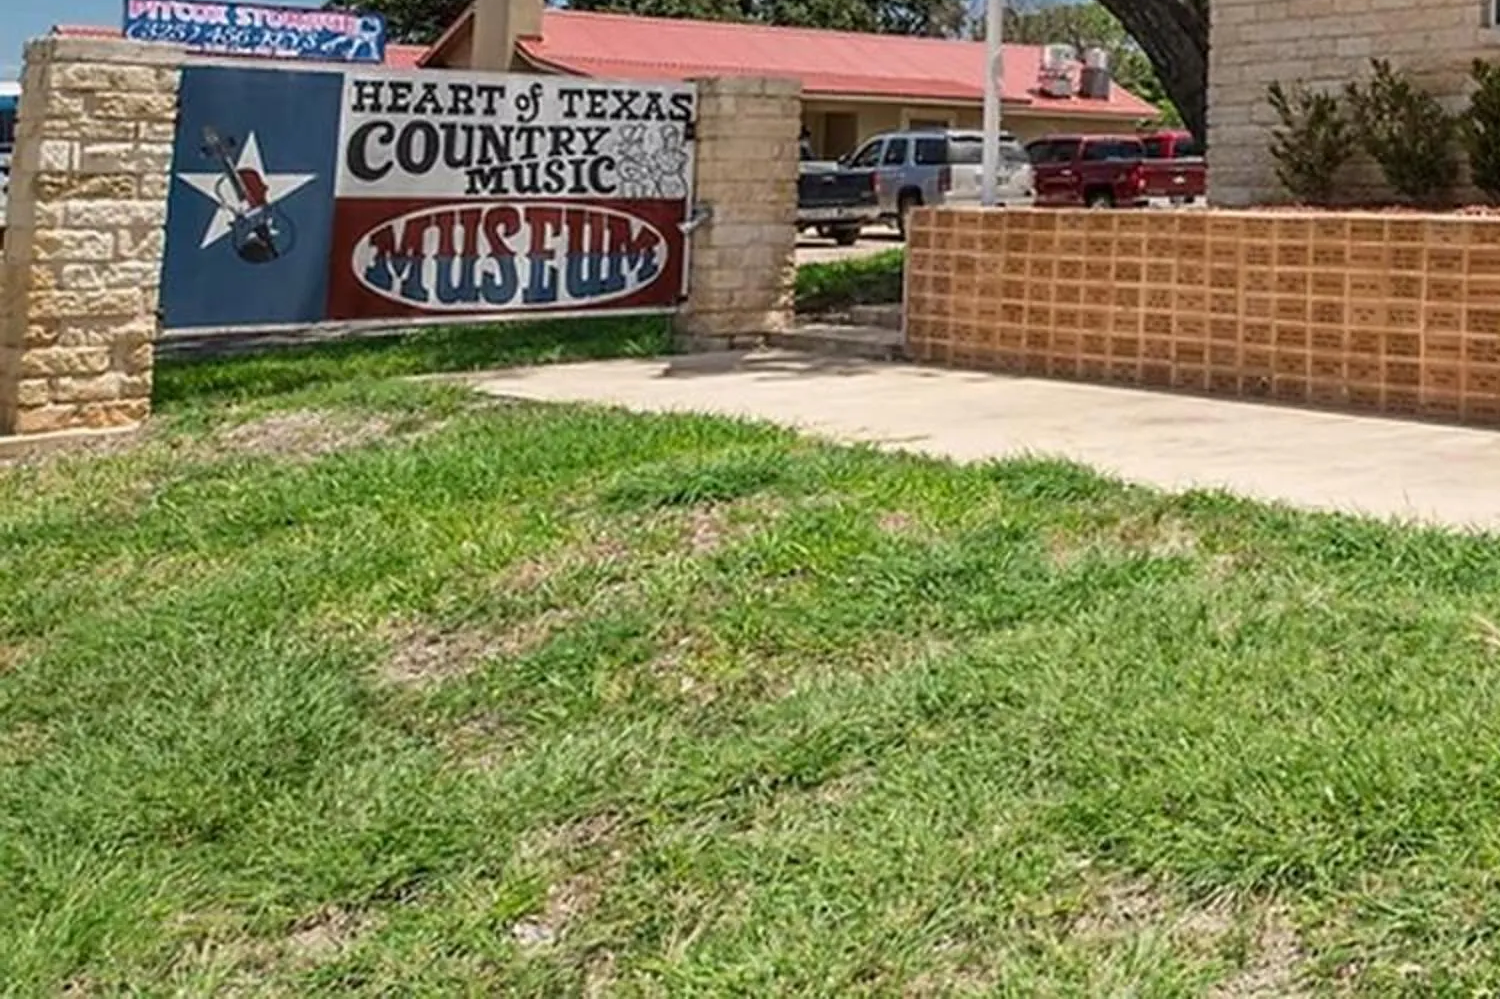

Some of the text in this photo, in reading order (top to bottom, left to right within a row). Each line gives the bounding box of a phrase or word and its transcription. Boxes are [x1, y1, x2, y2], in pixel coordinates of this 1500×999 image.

[351, 80, 694, 123] HEART of TEXAS
[346, 119, 611, 181] COUNTRY
[464, 155, 617, 196] MUSIC
[364, 205, 662, 304] MUSEUM
